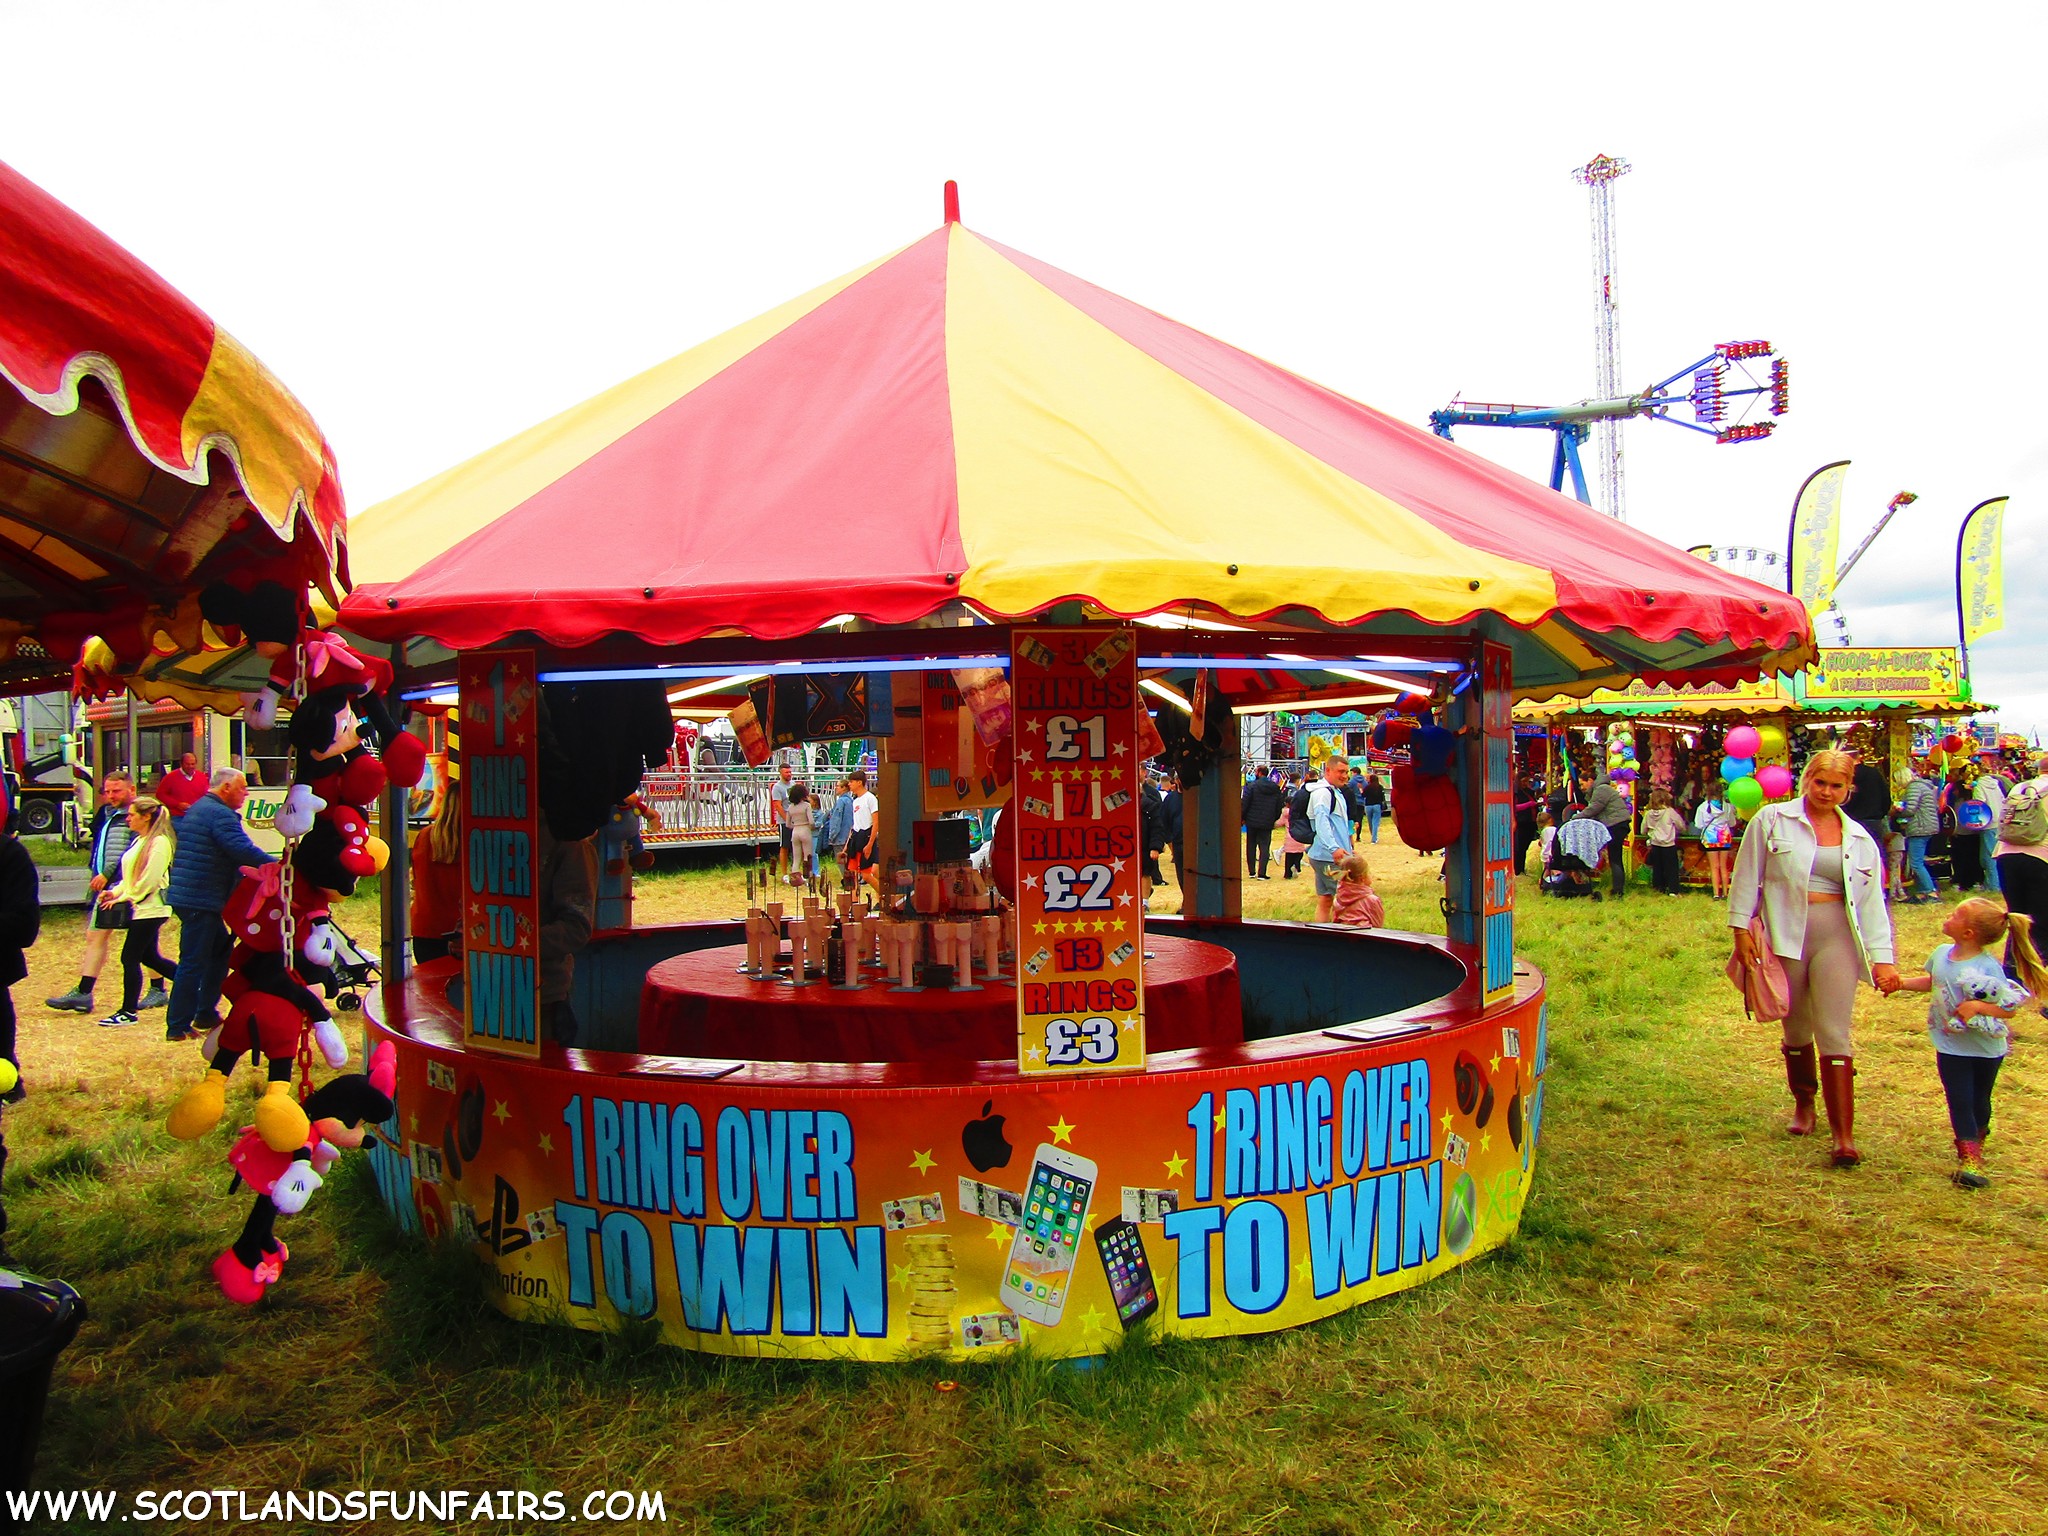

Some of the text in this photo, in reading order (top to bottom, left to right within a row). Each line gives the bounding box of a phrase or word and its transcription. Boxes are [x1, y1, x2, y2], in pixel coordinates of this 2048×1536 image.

[1061, 634, 1088, 666] 3
[1825, 651, 1934, 672] HOOK-A-DUCK
[488, 661, 504, 747] 1
[1018, 676, 1133, 711] RINGS
[1045, 714, 1107, 762] £1
[470, 755, 528, 819] RING
[469, 828, 532, 896] OVER
[1020, 826, 1136, 861] RINGS
[1044, 864, 1114, 912] £2
[485, 904, 516, 949] TO
[1054, 937, 1104, 971] 13
[469, 953, 535, 1044] WIN
[1023, 978, 1138, 1016] RINGS
[1045, 1016, 1118, 1067] £3
[1187, 1058, 1432, 1202] 1 RING OVER
[562, 1093, 860, 1224] 1 RING OVER
[1164, 1159, 1443, 1320] TO WIN
[554, 1199, 889, 1340] TO WIN
